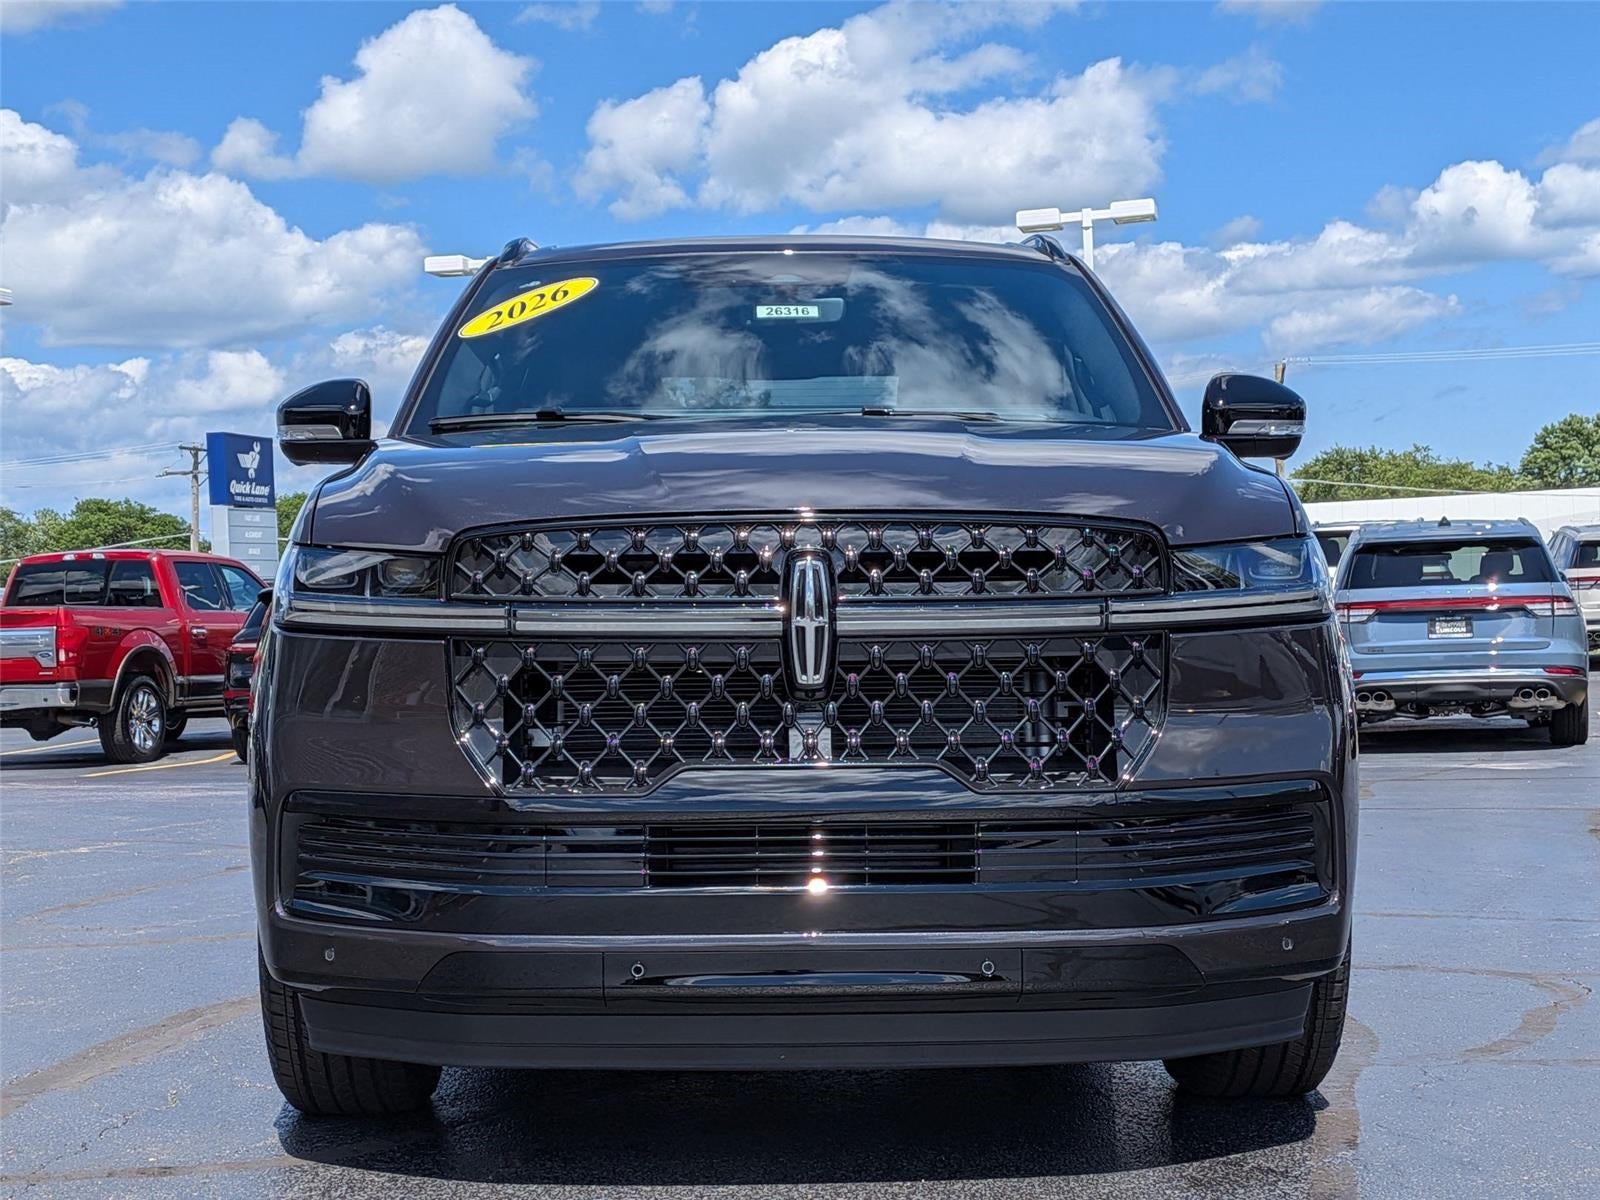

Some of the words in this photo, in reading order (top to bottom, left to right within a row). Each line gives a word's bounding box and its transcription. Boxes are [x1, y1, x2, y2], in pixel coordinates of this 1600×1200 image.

[486, 283, 569, 330] 2026
[766, 306, 810, 316] 26316
[230, 479, 251, 495] Quick
[251, 482, 270, 496] Lane
